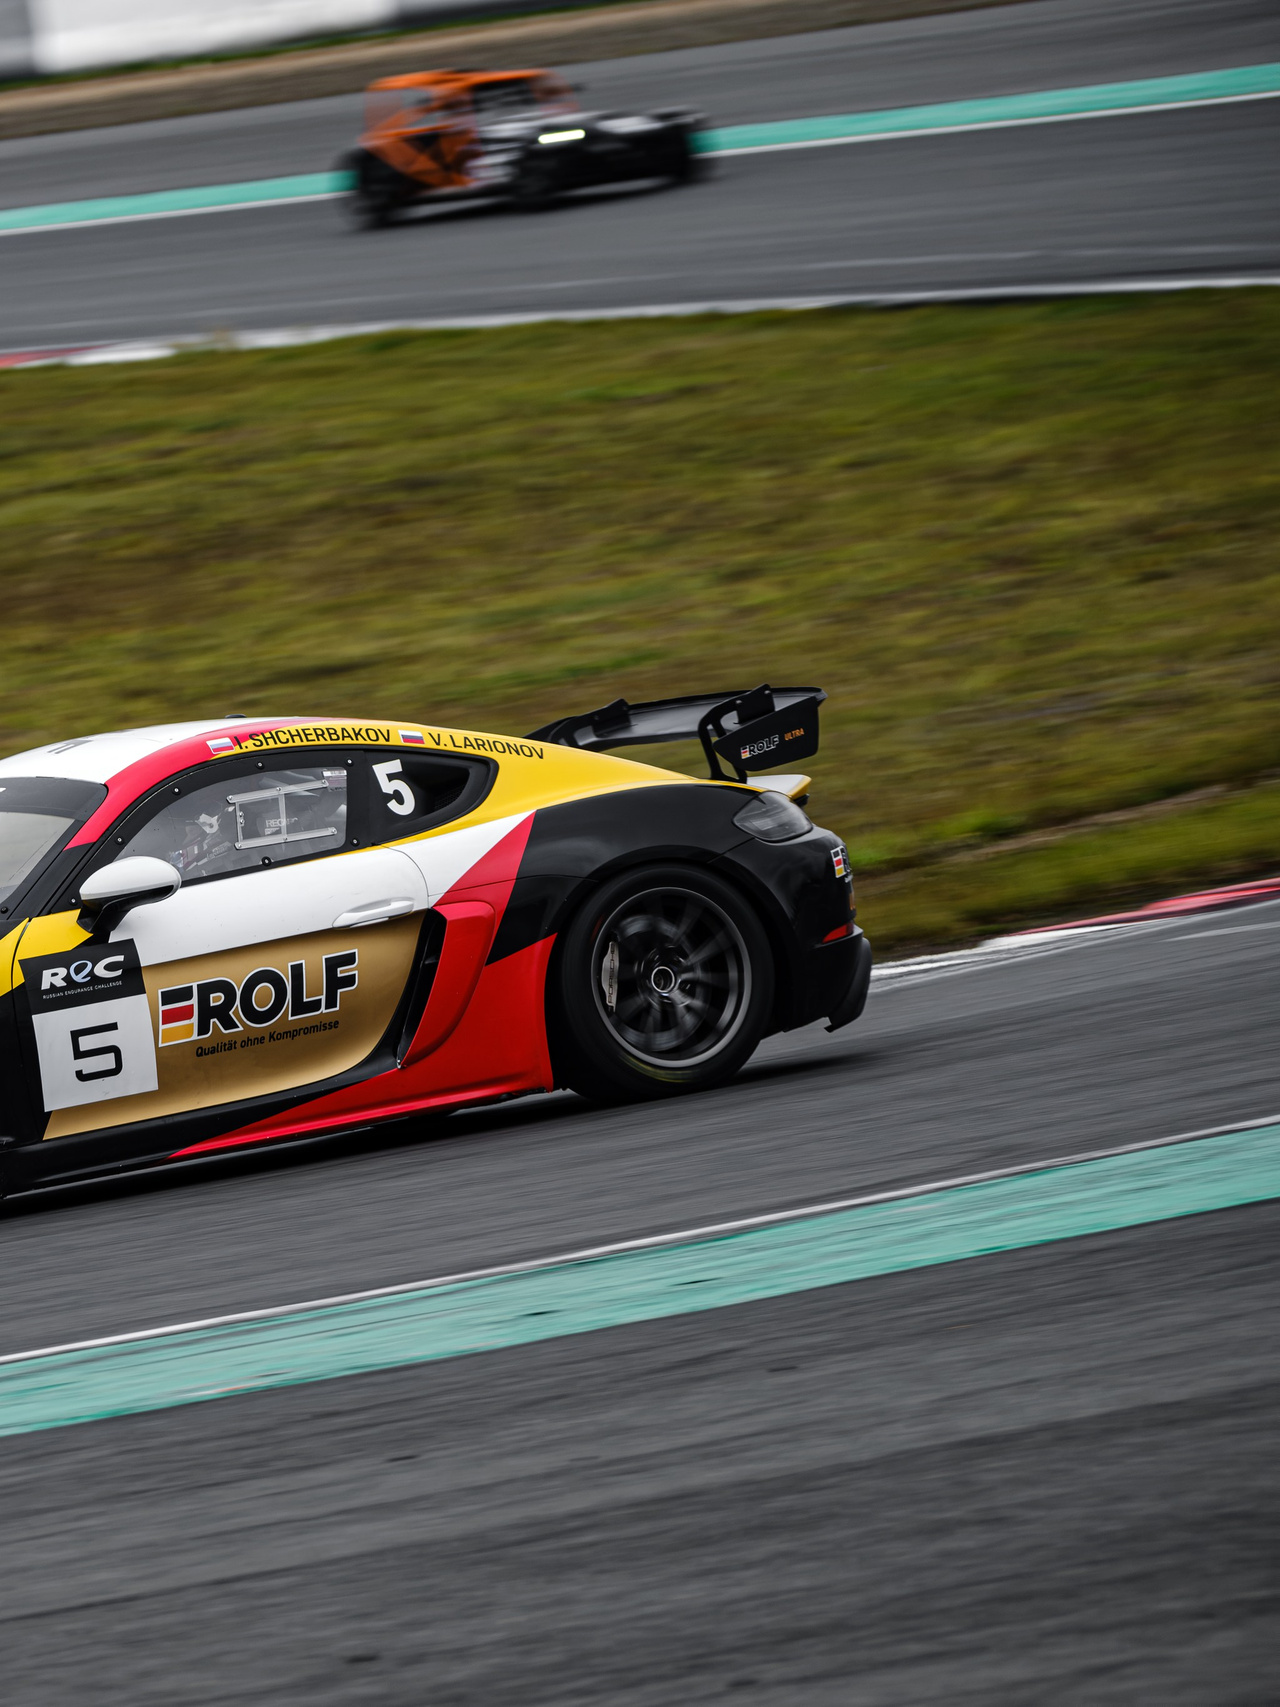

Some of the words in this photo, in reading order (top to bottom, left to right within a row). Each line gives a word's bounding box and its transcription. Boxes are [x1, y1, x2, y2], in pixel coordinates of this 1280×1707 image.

[233, 735, 248, 750] I.
[249, 727, 391, 748] SHCHERBAKOV
[427, 732, 448, 747] V.
[449, 733, 545, 760] LARIONOV
[748, 734, 780, 757] ROLF
[784, 727, 805, 741] ULTRA
[372, 759, 416, 816] 5
[42, 991, 64, 1000] RUSSIAN
[64, 985, 94, 996] ENDURANCE
[94, 980, 123, 990] CHALLENGE
[195, 948, 359, 1039] ROLF
[70, 1021, 123, 1082] 5
[195, 1039, 238, 1058] Qualität
[240, 1035, 266, 1049] ohne
[268, 1020, 340, 1043] Kompromisse
